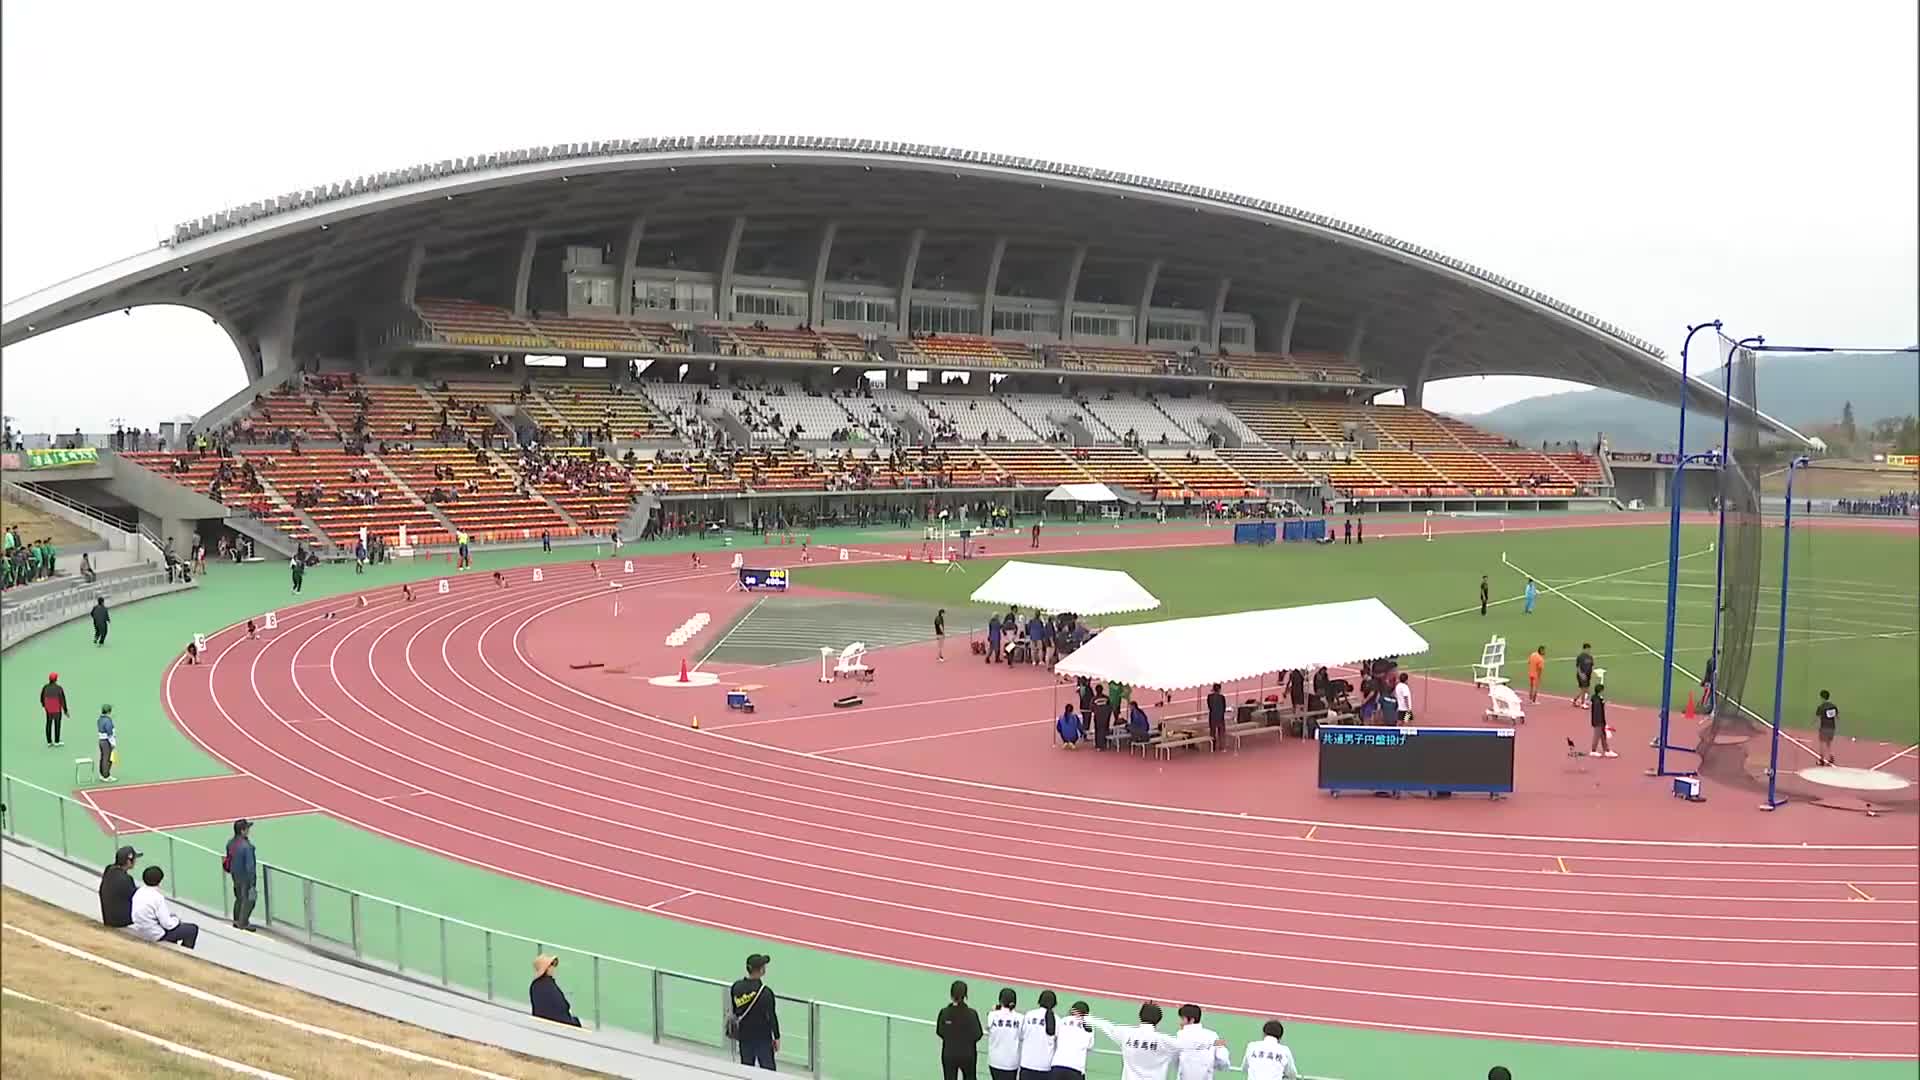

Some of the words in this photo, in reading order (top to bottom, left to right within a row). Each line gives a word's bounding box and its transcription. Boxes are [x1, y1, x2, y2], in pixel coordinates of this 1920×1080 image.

[1323, 733, 1407, 746] 共通男子円盤投げ
